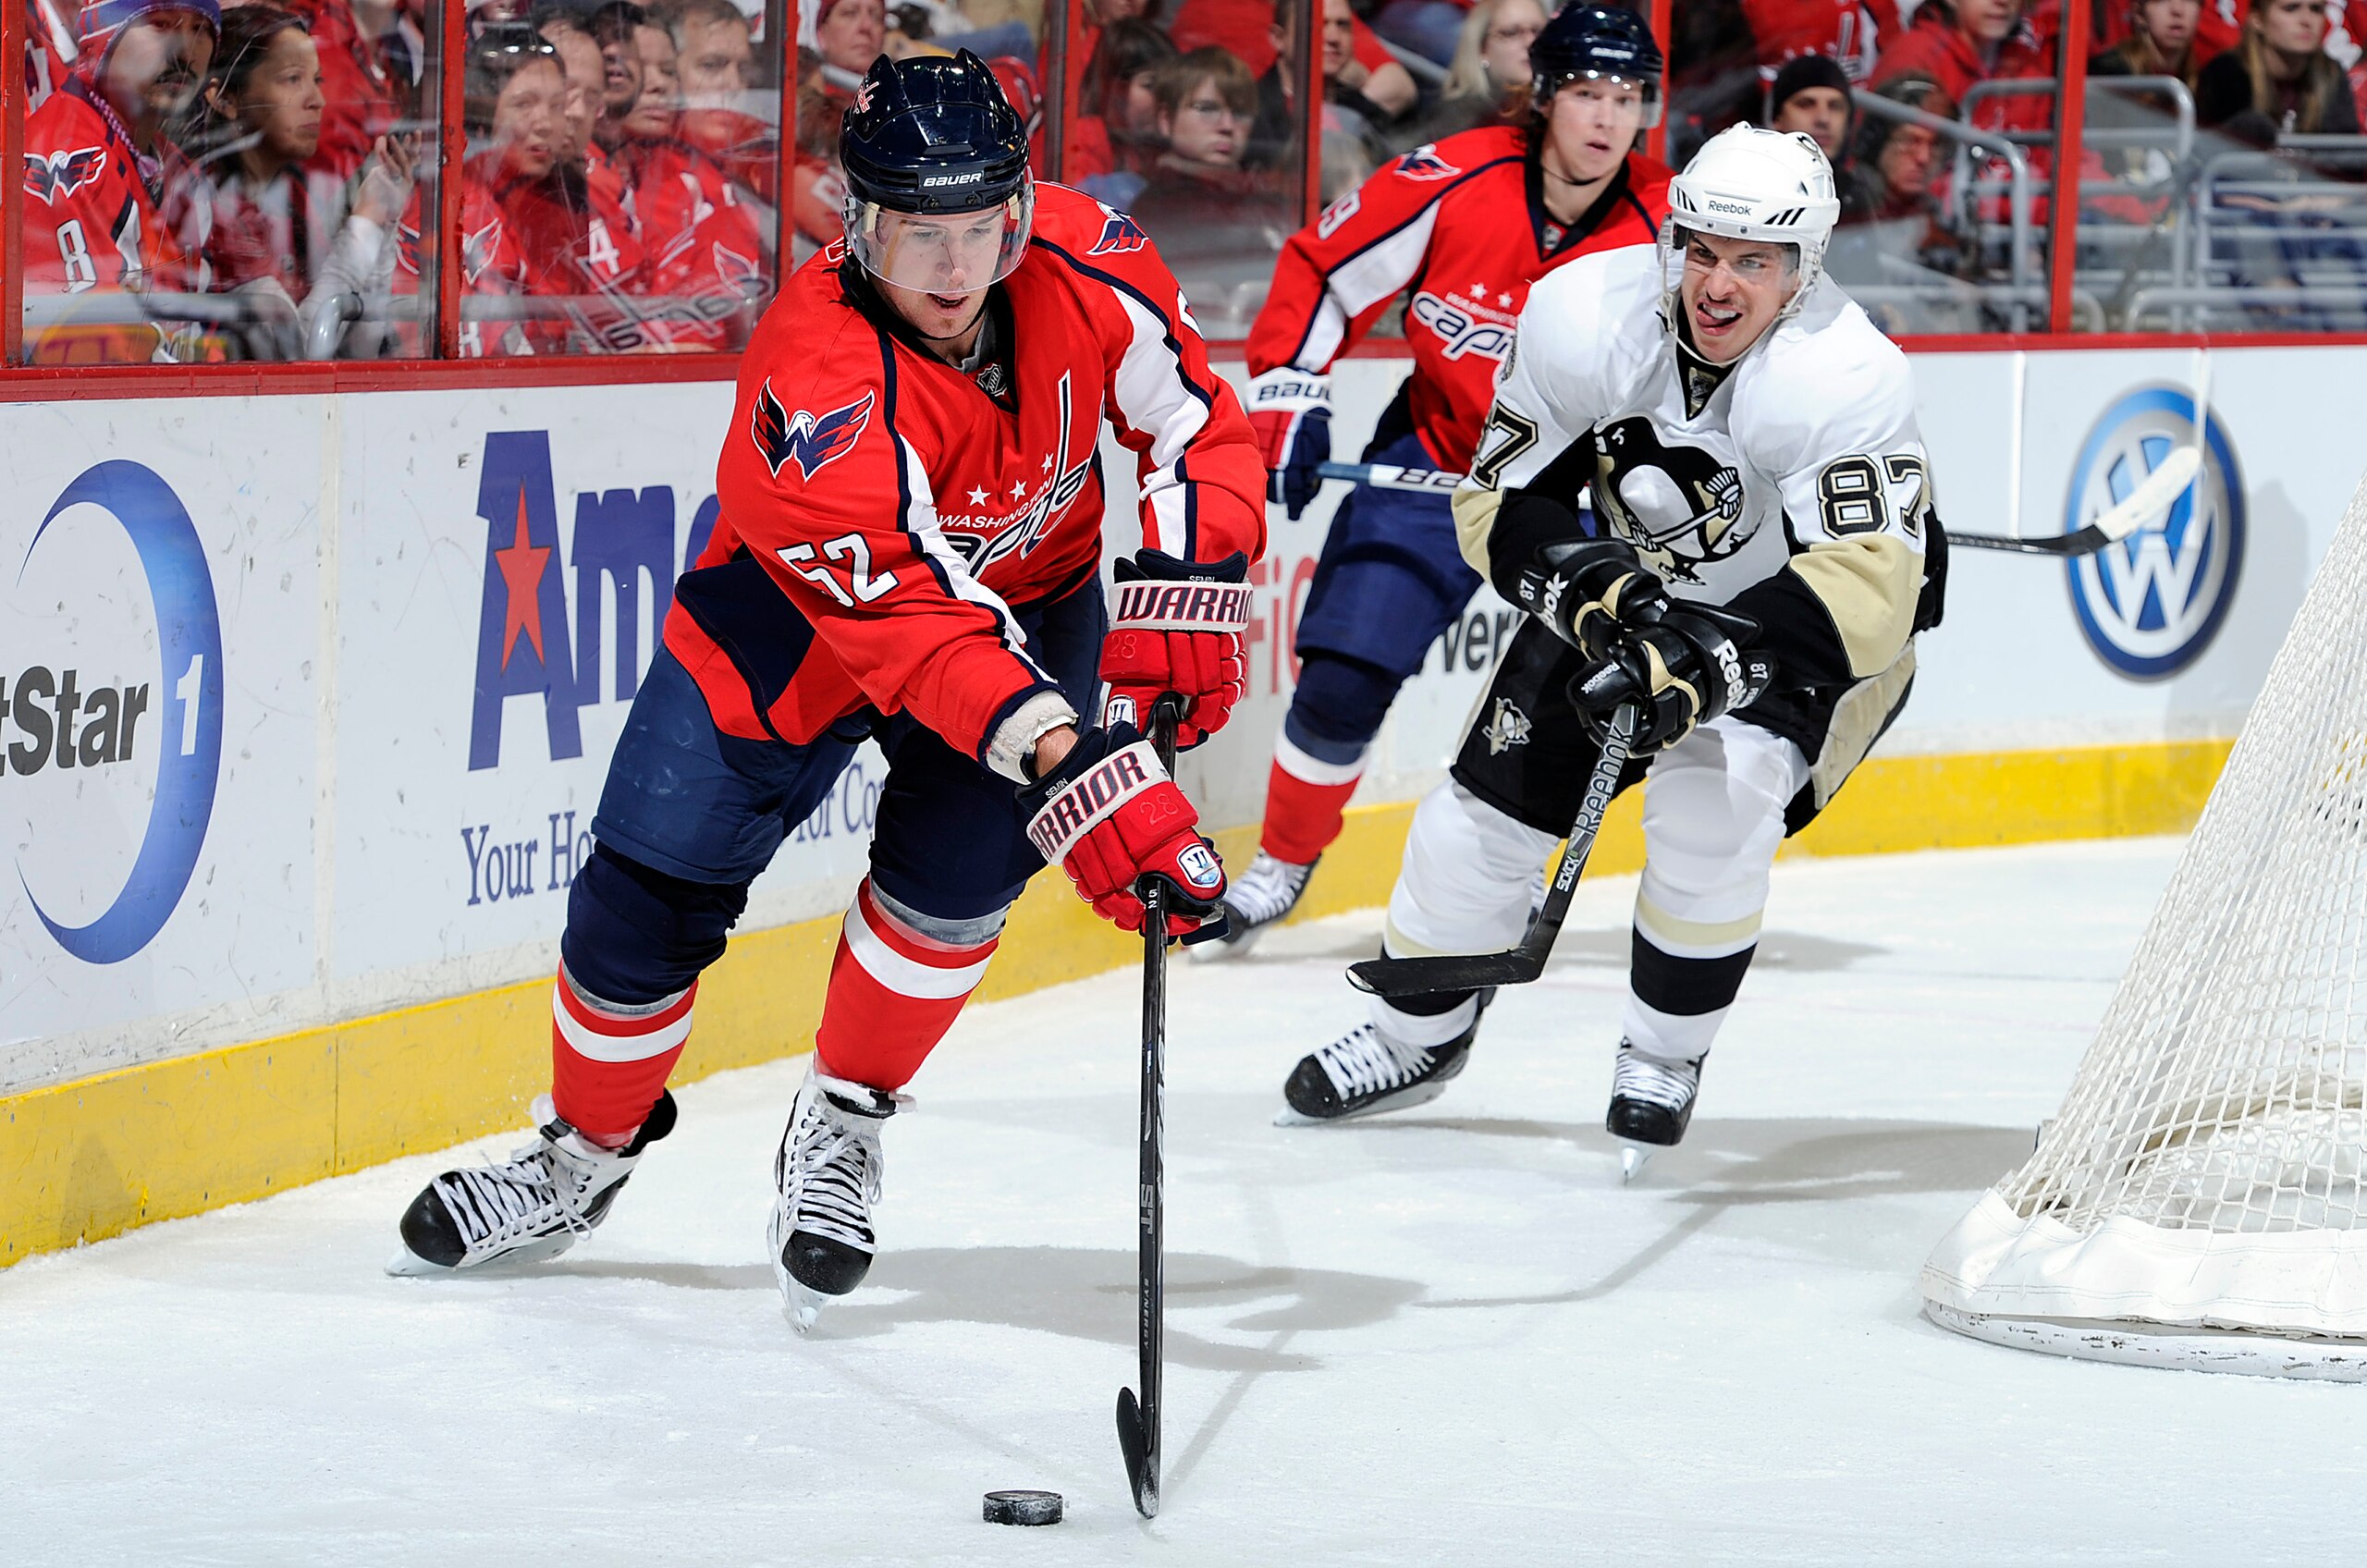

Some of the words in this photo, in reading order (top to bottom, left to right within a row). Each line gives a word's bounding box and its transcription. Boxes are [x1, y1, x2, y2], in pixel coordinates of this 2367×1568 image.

[1708, 200, 1751, 215] Reebok
[56, 219, 96, 293] 8
[1257, 383, 1331, 401] BAU
[1471, 398, 1539, 491] 7
[939, 475, 1052, 530] WASHINGTON
[1817, 454, 1922, 539] 87
[775, 532, 900, 607] 52
[1519, 579, 1535, 601] 87
[1581, 661, 1620, 694] Reebok
[1750, 663, 1768, 679] 87
[176, 654, 203, 756] 1
[843, 763, 885, 833] Co
[1045, 778, 1069, 799] SEMIN
[460, 824, 538, 906] Your
[547, 811, 594, 890] Ho
